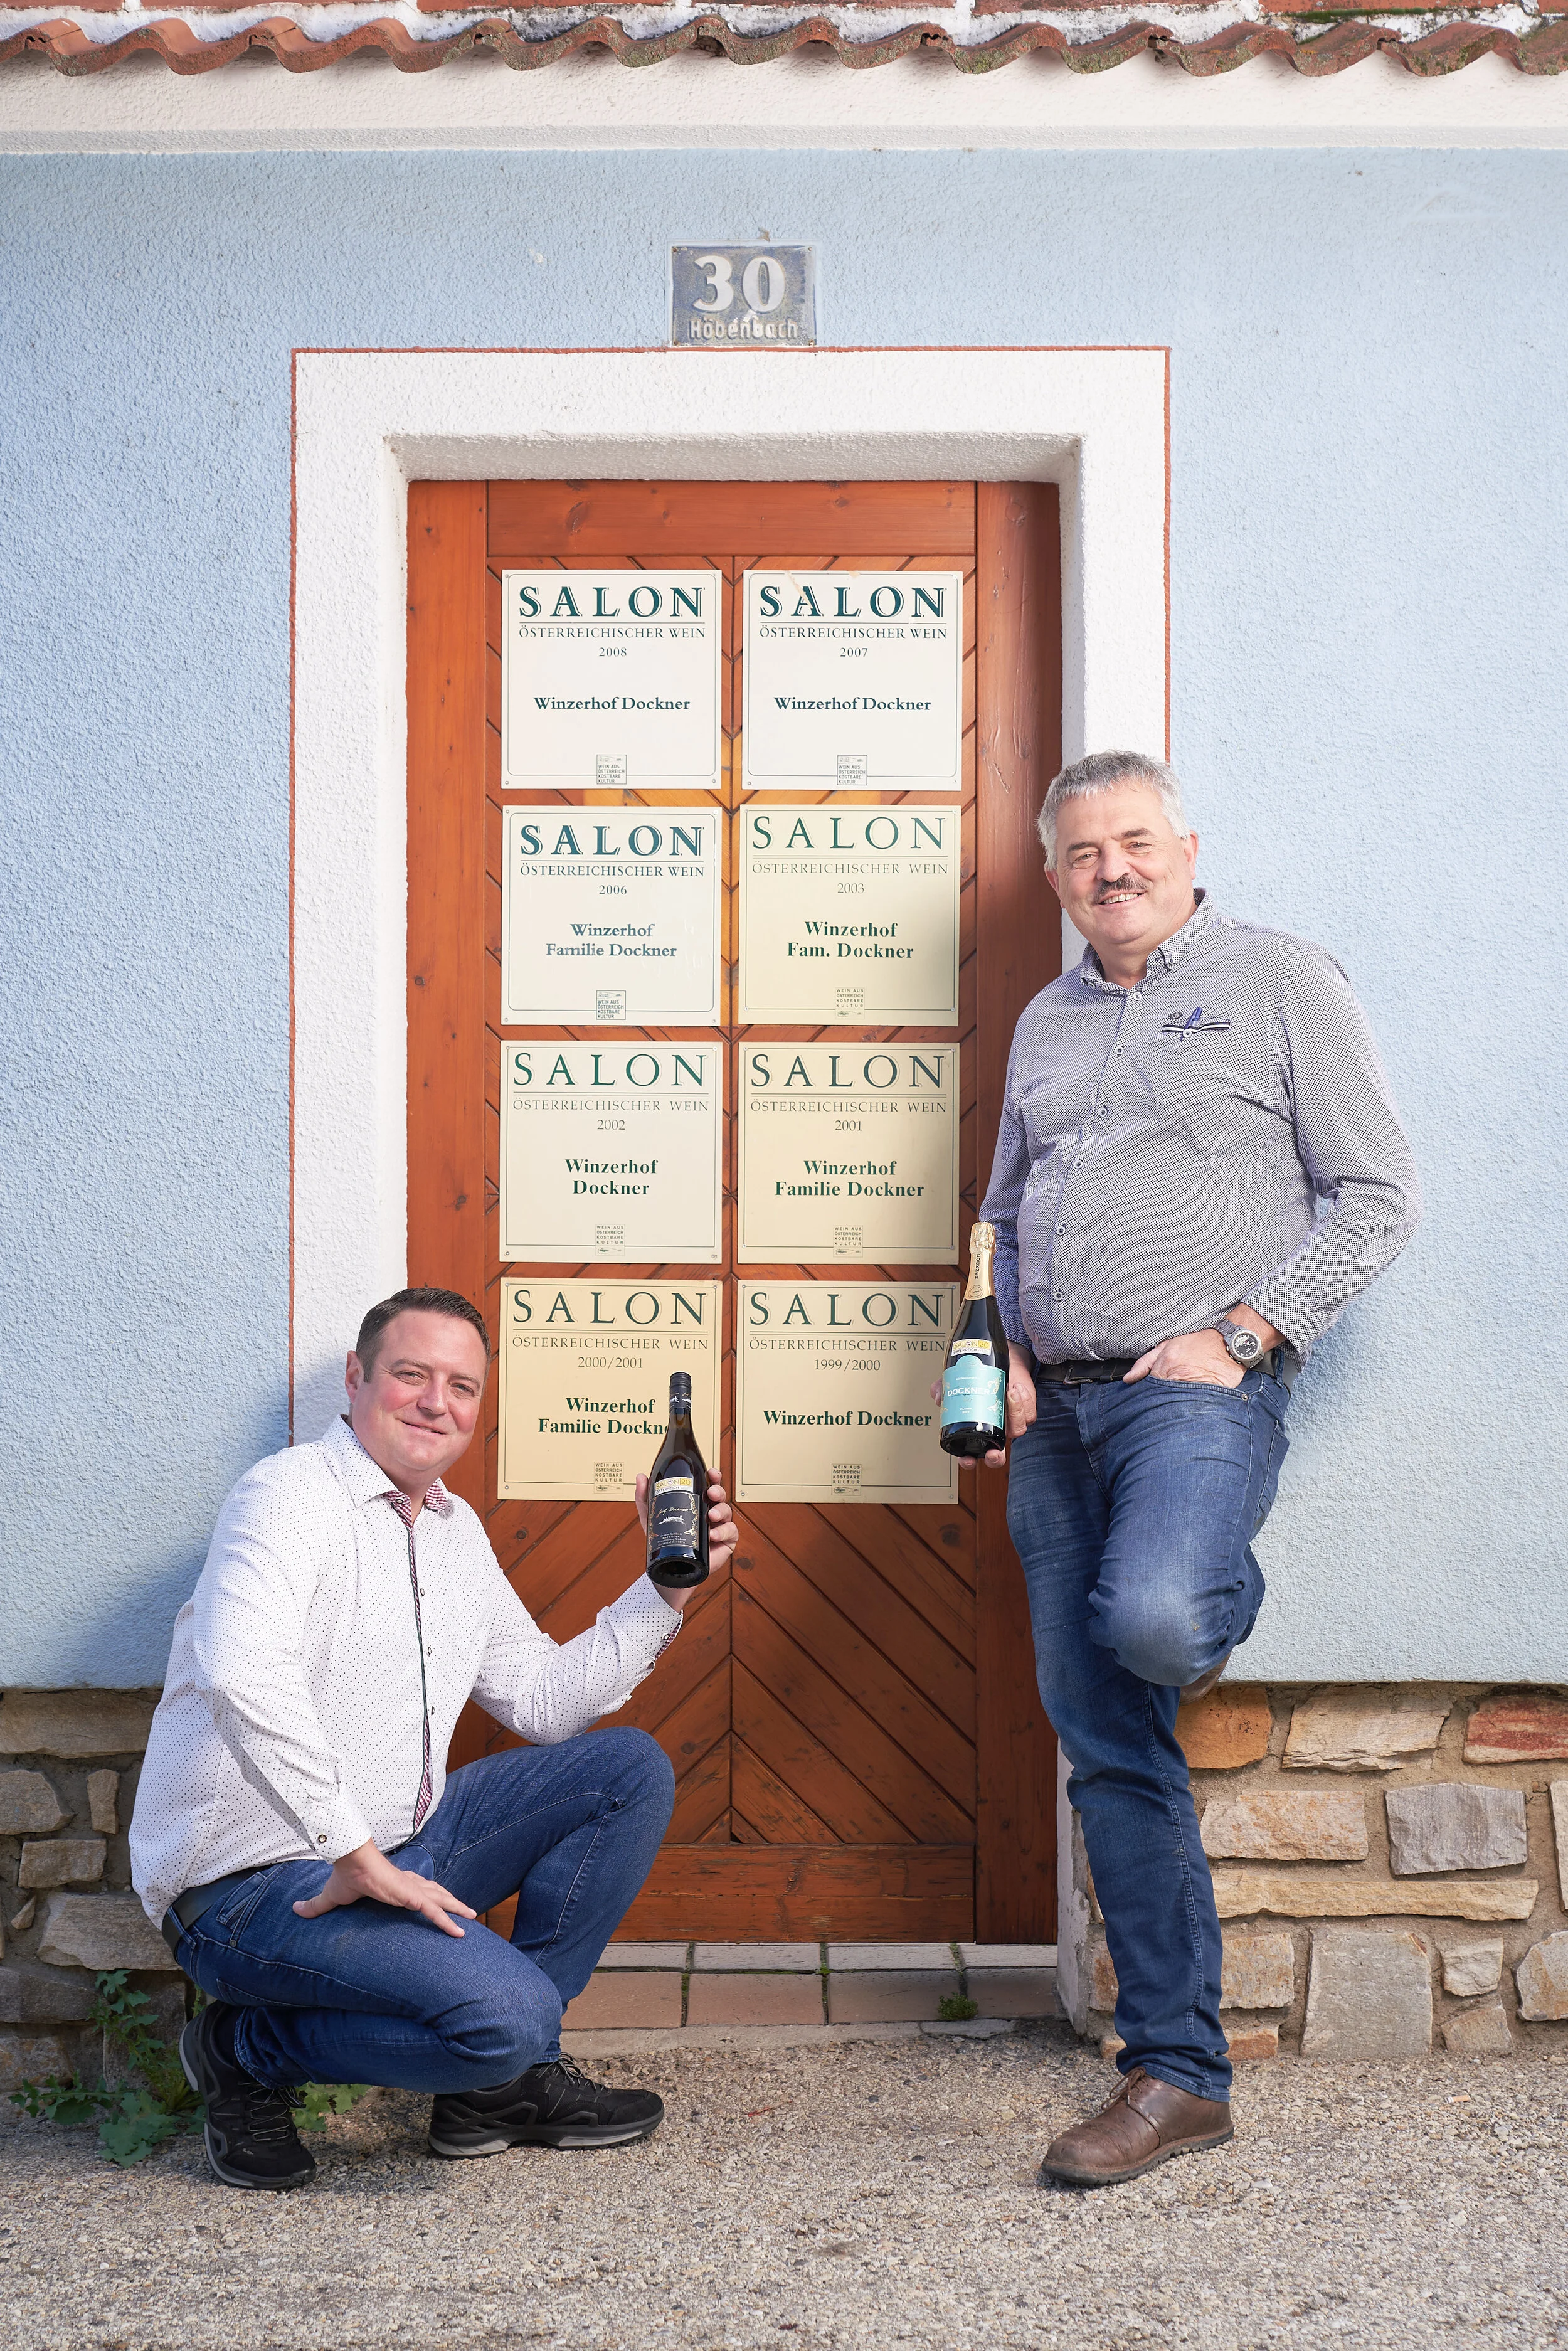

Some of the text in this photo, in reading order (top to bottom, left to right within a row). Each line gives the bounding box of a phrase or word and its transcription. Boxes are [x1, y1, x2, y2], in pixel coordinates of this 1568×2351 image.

[691, 255, 786, 314] 30
[689, 317, 798, 340] Höbenbach
[519, 586, 706, 618] SALON
[760, 585, 947, 618] SALON
[519, 625, 706, 639] ÖSTERREICHISCHER WEIN
[760, 624, 947, 639] ÖSTERREICHISCHER WEIN
[598, 647, 627, 657] 2008
[839, 647, 868, 658] 2007
[533, 696, 691, 710] Winzerhof Dockner
[773, 696, 931, 711] Winzerhof Dockner
[521, 825, 705, 856] SALON
[753, 815, 946, 850] SALON
[521, 862, 705, 877] ÖSTERREICHISCHER WEIN
[752, 861, 948, 874] ÖSTERREICHISCHER WEIN
[599, 884, 627, 895] 2006
[837, 883, 864, 894] 2003
[570, 923, 655, 937] Winzerhof
[805, 921, 898, 937] Winzerhof
[546, 943, 677, 957] Familie Dockner
[787, 942, 914, 958] Fam. Dockner
[513, 1053, 707, 1087] SALON
[751, 1054, 945, 1088] SALON
[513, 1098, 709, 1112] ÖSTERREICHISCHER WEIN
[750, 1099, 947, 1113] ÖSTERREICHISCHER WEIN
[596, 1119, 626, 1131] 2002
[834, 1120, 862, 1132] 2001
[564, 1158, 659, 1174] Winzerhof
[803, 1160, 897, 1176] Winzerhof
[573, 1179, 650, 1195] Dockner
[775, 1181, 924, 1197] Familie Dockner
[513, 1289, 707, 1325] SALON
[750, 1292, 944, 1327] SALON
[512, 1334, 709, 1350] ÖSTERREICHISCHER WEIN
[749, 1337, 945, 1351] ÖSTERREICHISCHER WEIN
[947, 1387, 990, 1397] DOCKNER
[565, 1397, 656, 1414] Winzerhof
[763, 1410, 933, 1426] Winzerhof Dockner
[538, 1418, 668, 1435] Familie Dockn
